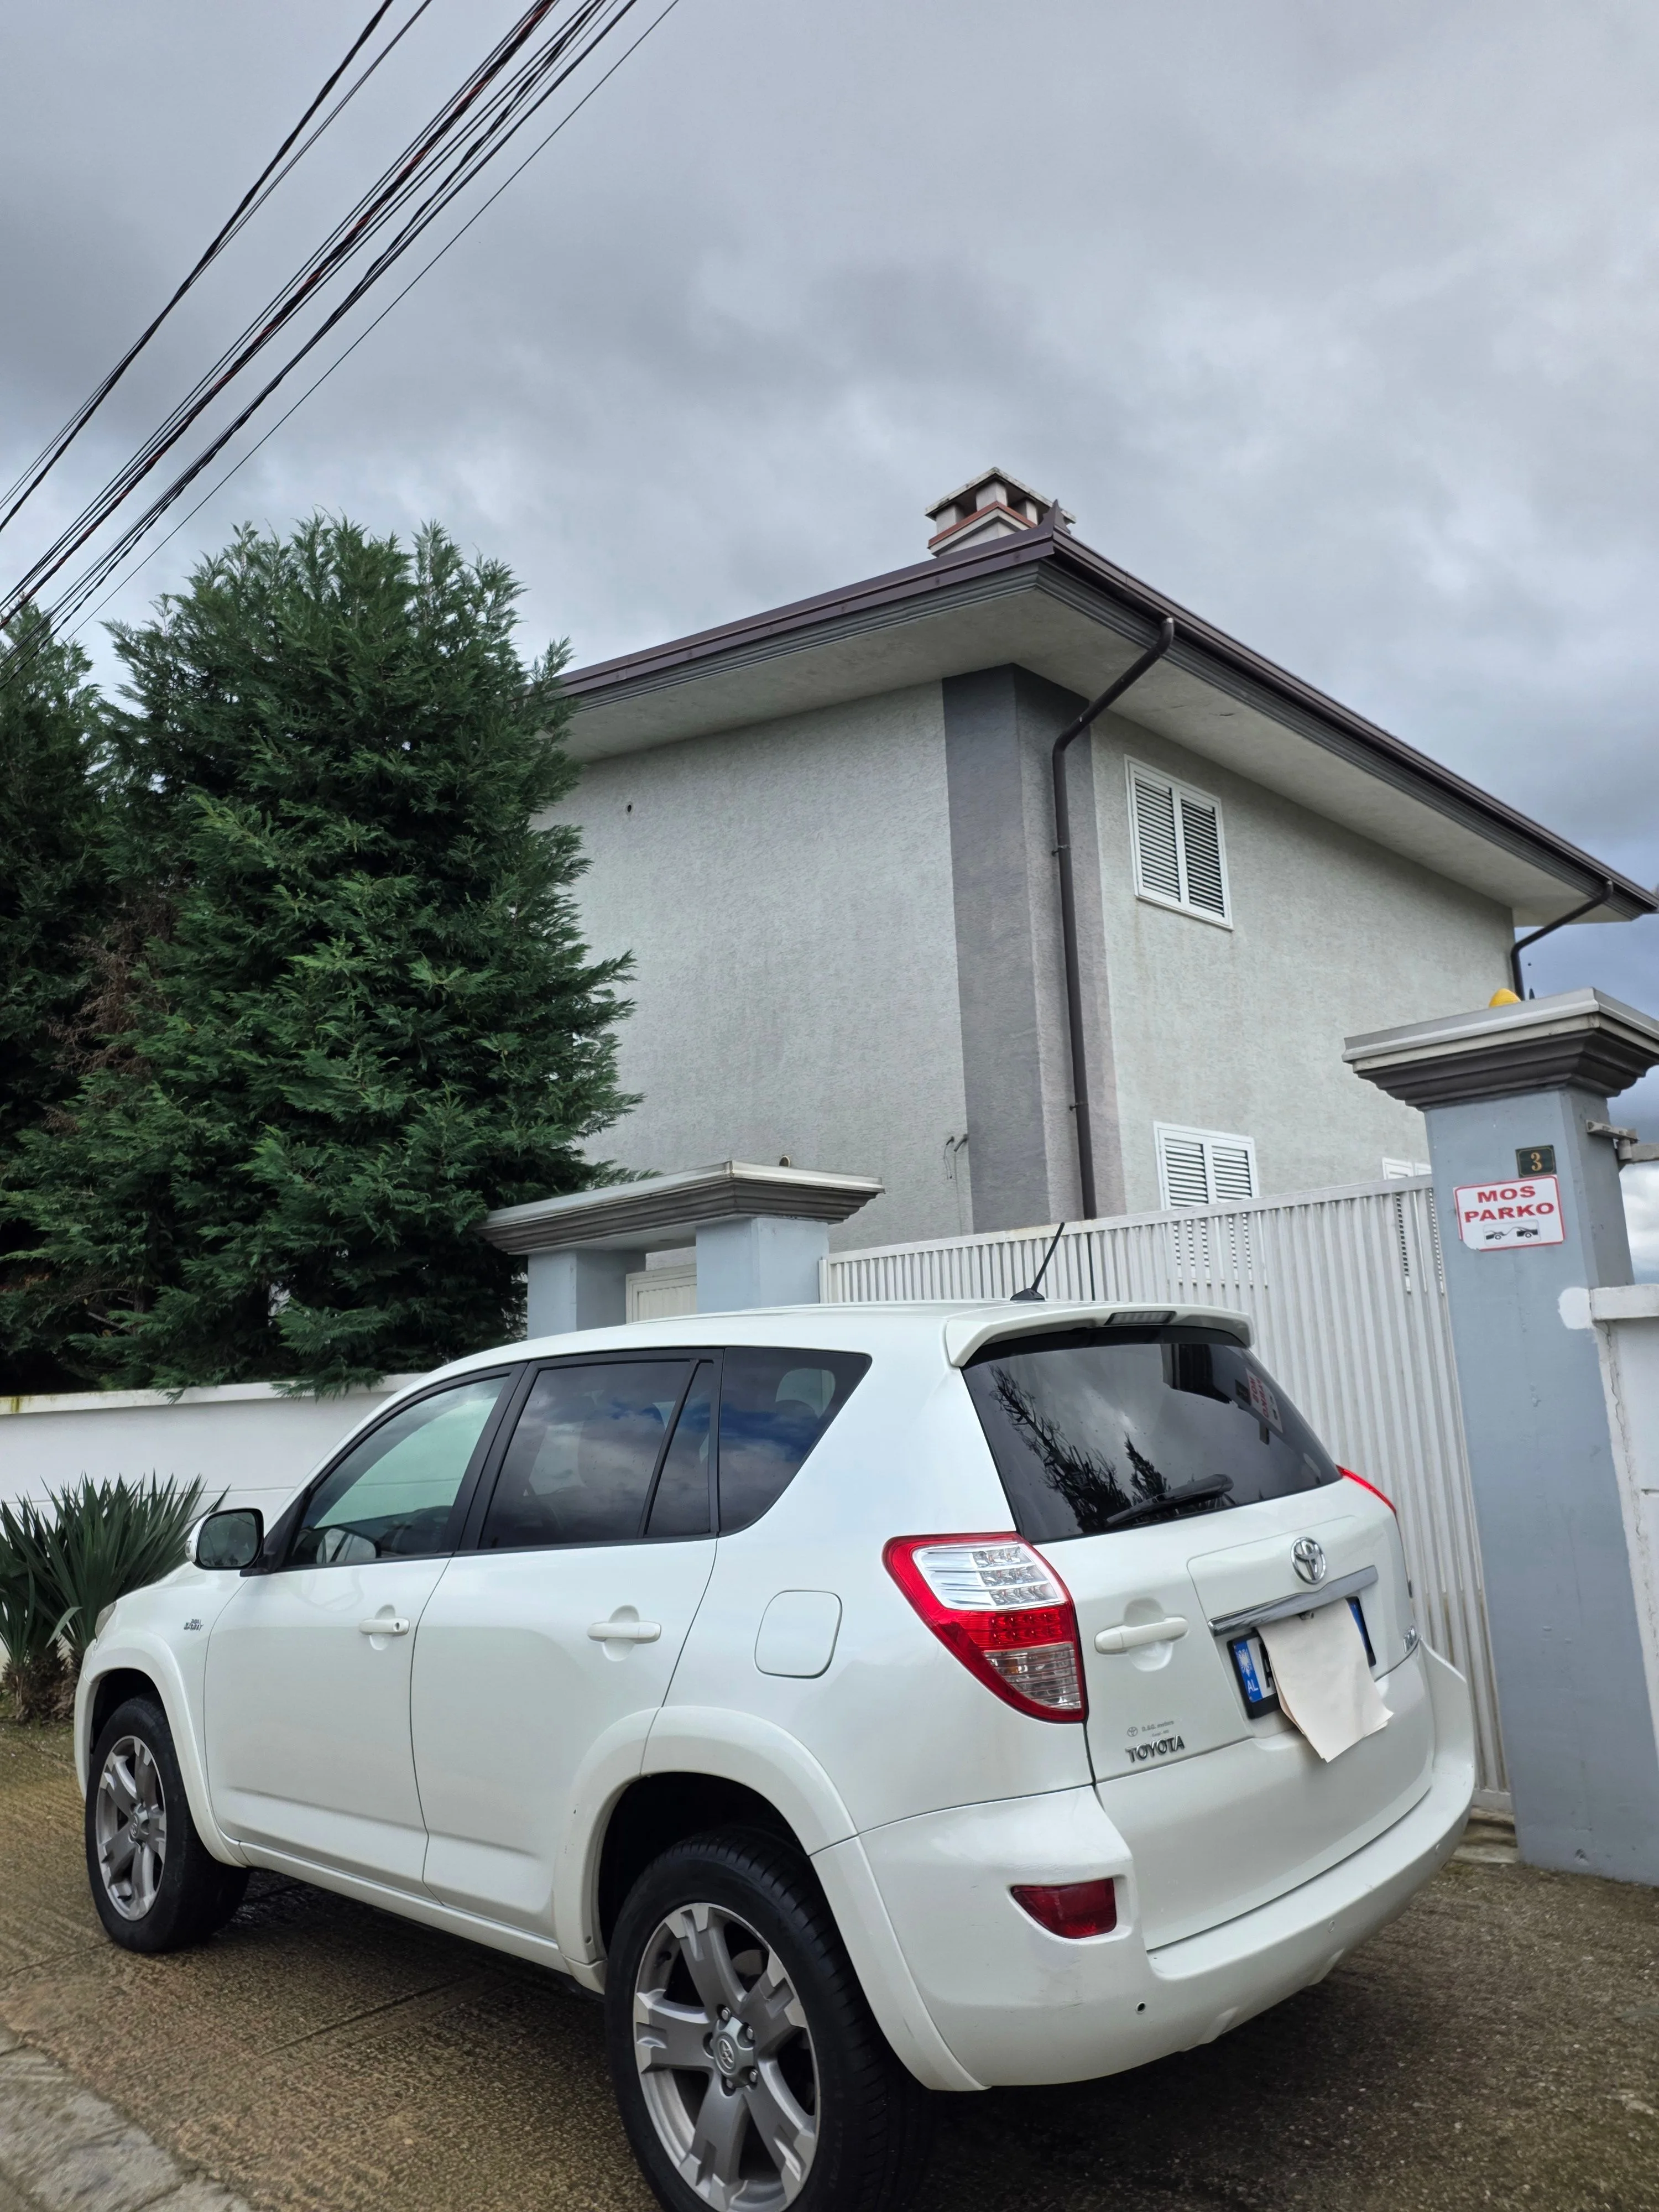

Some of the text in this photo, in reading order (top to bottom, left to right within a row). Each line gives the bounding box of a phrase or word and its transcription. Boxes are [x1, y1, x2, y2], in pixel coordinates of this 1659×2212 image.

[1530, 1152, 1542, 1171] 3
[1477, 1186, 1536, 1203] MOS
[1464, 1202, 1554, 1223] PARKO
[1247, 1678, 1259, 1694] AL
[1124, 1734, 1186, 1764] TOYOTA
